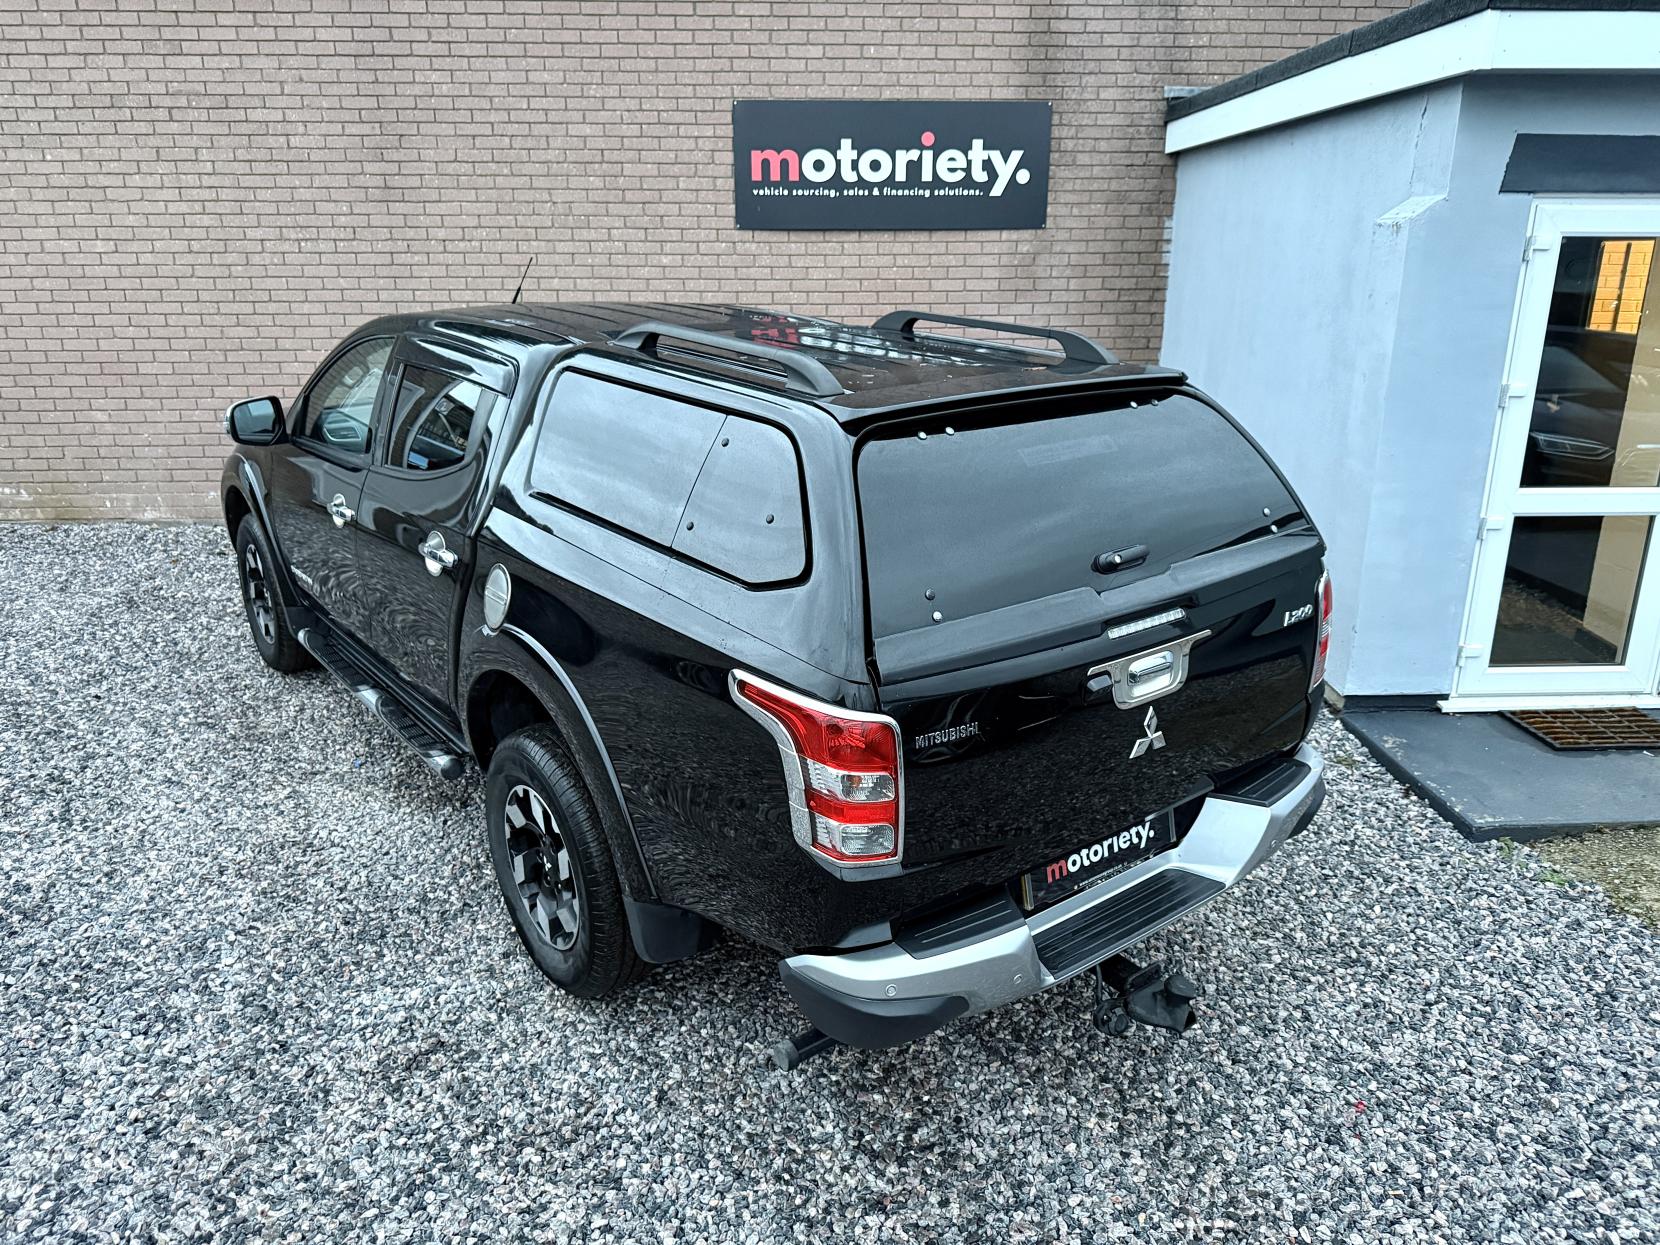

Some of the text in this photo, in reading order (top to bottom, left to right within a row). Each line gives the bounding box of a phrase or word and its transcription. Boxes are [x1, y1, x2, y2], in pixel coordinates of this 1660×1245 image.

[751, 131, 1031, 197] motoriety.
[752, 186, 984, 198] vehicle sourcing, sales & financing solutions.
[1283, 604, 1313, 627] L200
[915, 721, 979, 750] MITSUBISHI
[1046, 821, 1155, 884] motoriety.
